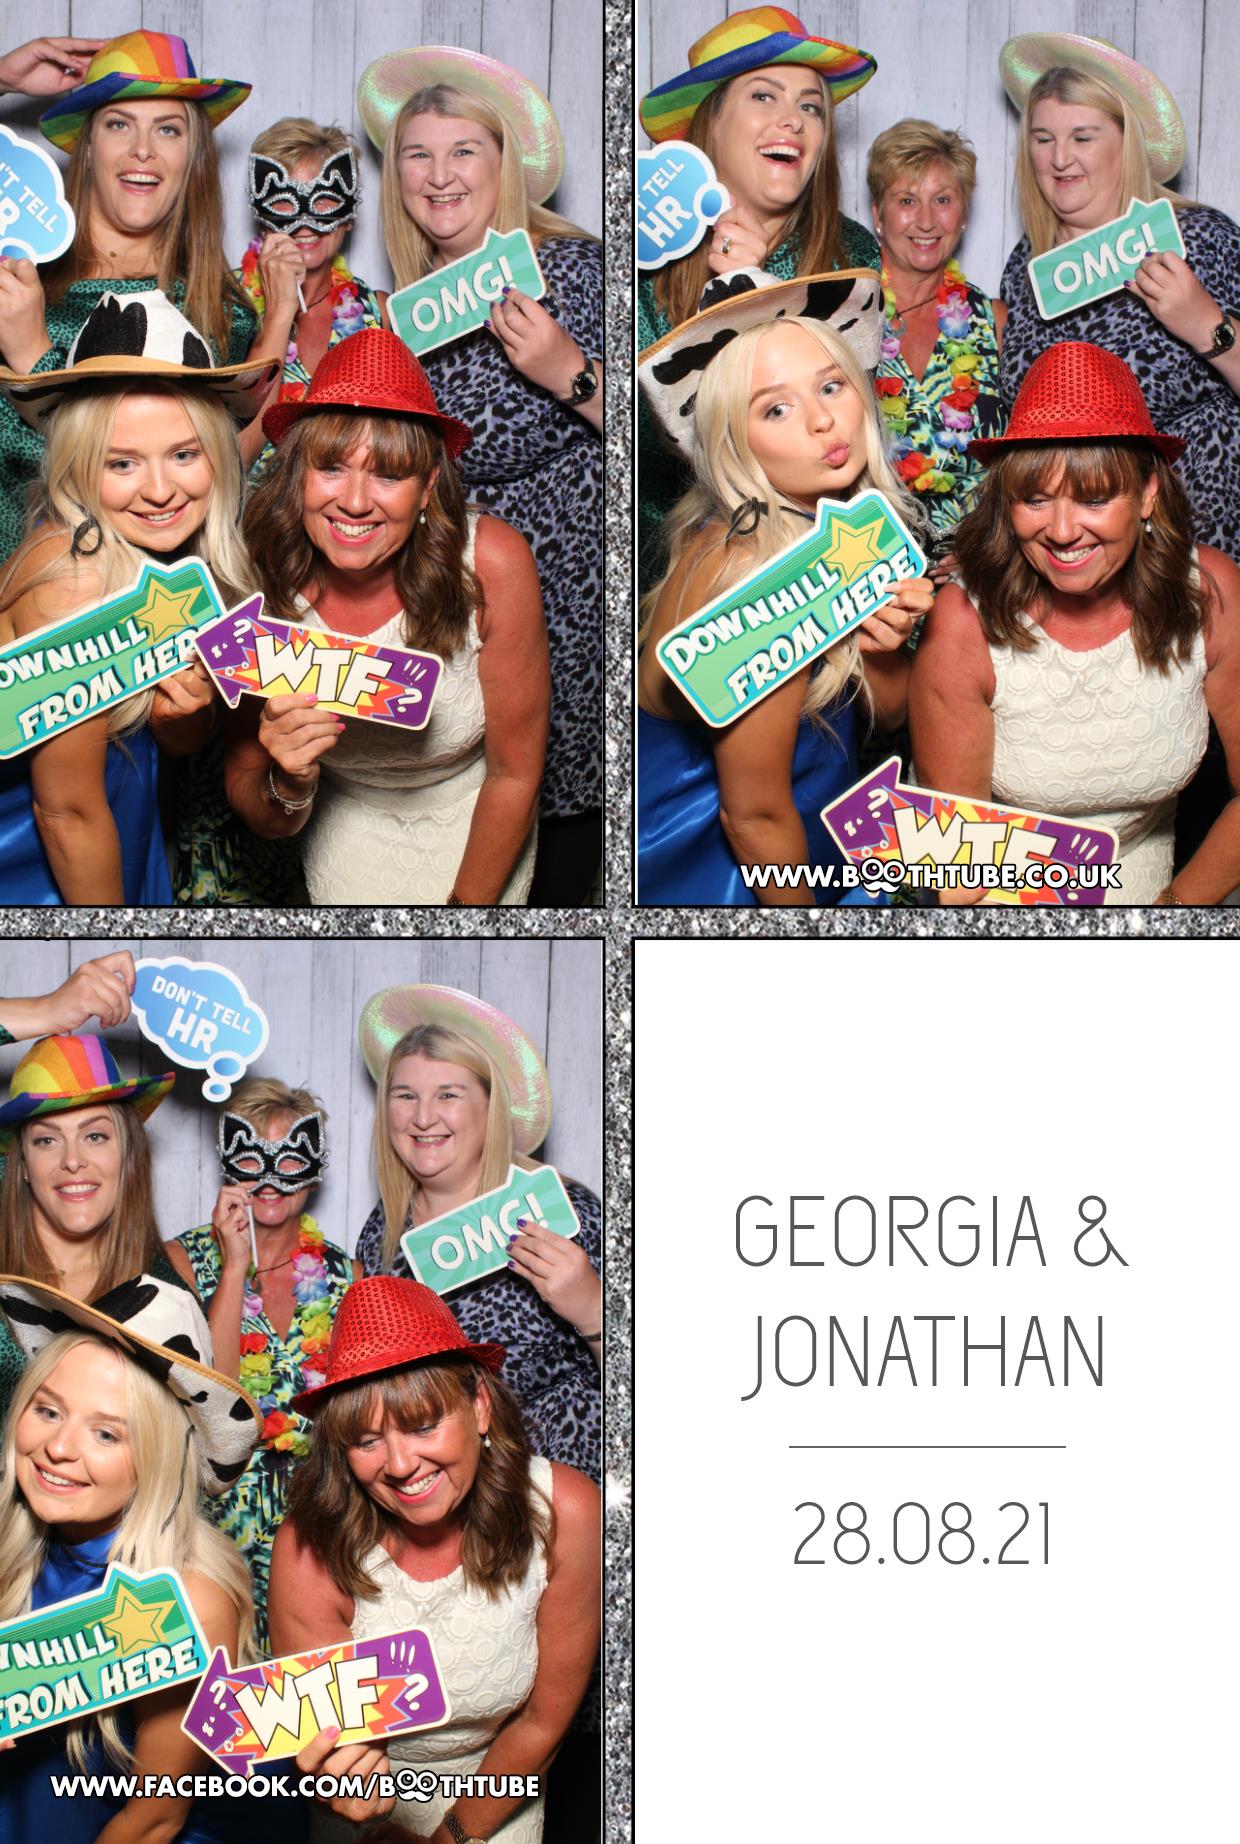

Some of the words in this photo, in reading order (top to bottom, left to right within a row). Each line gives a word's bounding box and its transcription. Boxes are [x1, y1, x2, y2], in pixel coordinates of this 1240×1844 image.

[18, 185, 58, 233] TELL
[642, 159, 685, 198] TELL
[638, 195, 694, 249] HR
[1053, 222, 1158, 294] OMG!
[411, 255, 517, 332] OMG!
[663, 559, 841, 676] DOWNHILL
[727, 612, 828, 705] FROM
[830, 544, 919, 630] HERE
[18, 664, 126, 741] FROM
[133, 614, 219, 686] HER
[254, 632, 394, 708] WTF
[893, 805, 1059, 892] WTF
[151, 975, 209, 1012] DON'T
[211, 1002, 252, 1036] TELL
[166, 1006, 219, 1055] HR
[431, 1192, 549, 1271] OMG!
[0, 1672, 92, 1729] ROM
[99, 1635, 198, 1700] HERE
[234, 1655, 380, 1751] WTF
